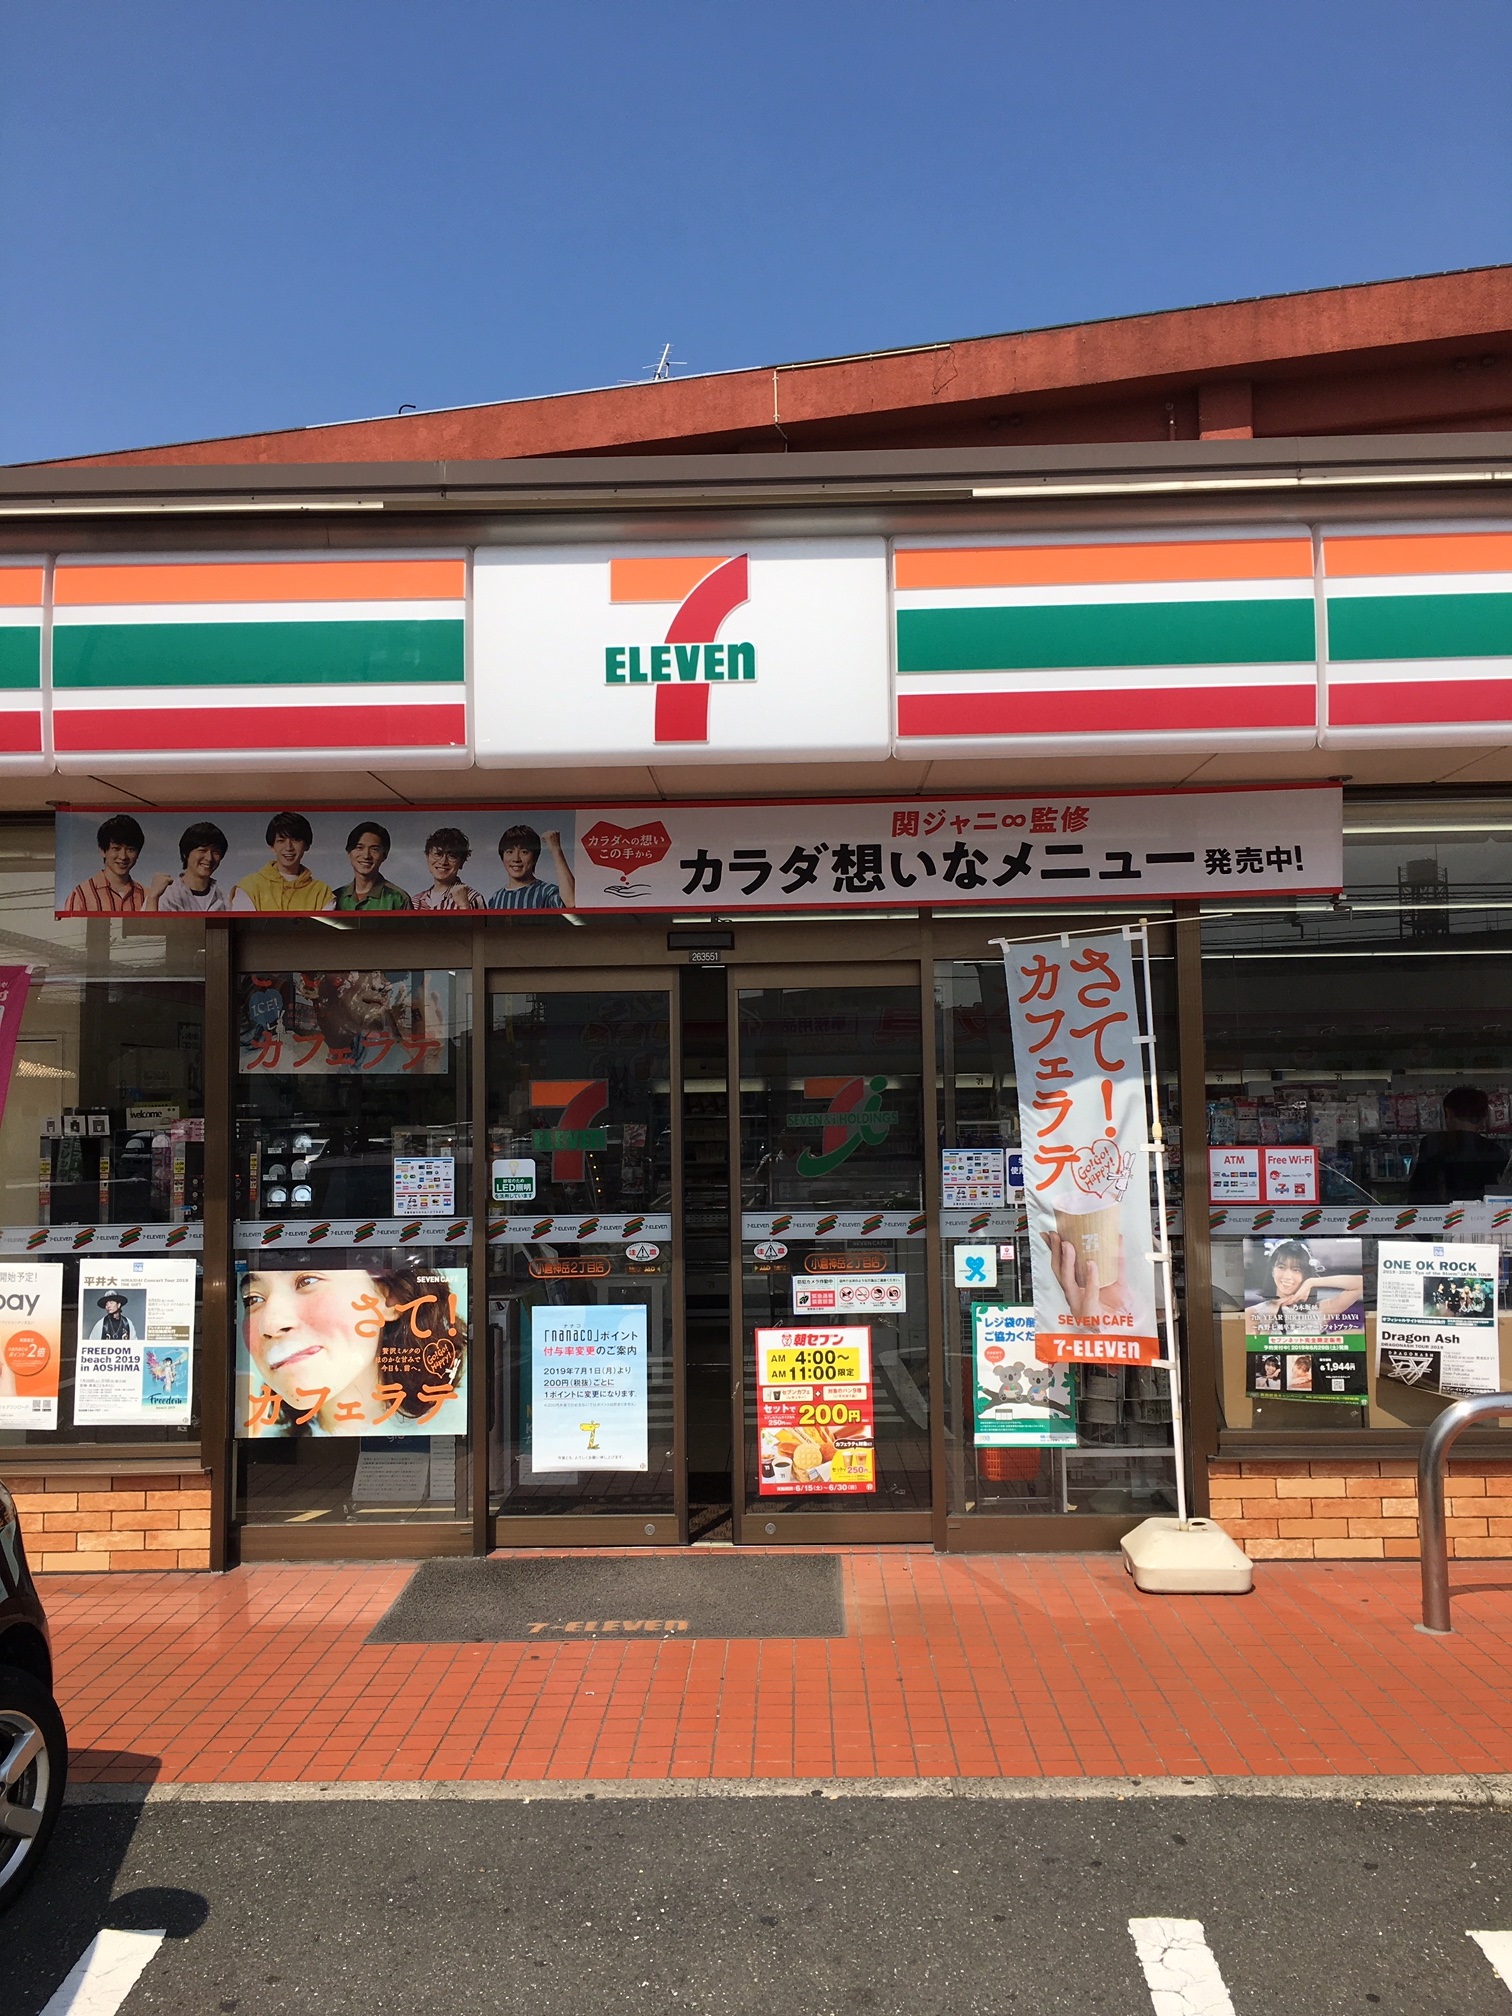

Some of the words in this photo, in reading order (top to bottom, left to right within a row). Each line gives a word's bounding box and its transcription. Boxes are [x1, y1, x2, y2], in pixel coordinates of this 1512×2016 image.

[891, 805, 1090, 838] 関ジャニ∞監修
[588, 833, 665, 847] カラダへの想い
[598, 848, 653, 860] この手から
[680, 842, 1195, 896] カラダ想いなメニュー
[1203, 845, 1304, 875] 発売中!
[691, 951, 719, 962] 263551
[1069, 948, 1128, 1138] さて!
[247, 1031, 441, 1070] カフェラテ
[1018, 954, 1081, 1191] カフェラテ
[1224, 1155, 1245, 1164] ATM
[1268, 1156, 1287, 1164] Free
[1288, 1156, 1312, 1164] Wi-Fi
[496, 1183, 532, 1192] LED照明
[1383, 1260, 1411, 1270] ONE
[1416, 1261, 1435, 1270] OK
[1439, 1261, 1477, 1272] ROCK
[84, 1276, 118, 1286] 平井大
[351, 1293, 458, 1339] さて!
[1058, 1314, 1101, 1326] SEVEN
[1102, 1312, 1134, 1327] CAFÉ
[793, 1334, 844, 1347] 朝セブン
[985, 1331, 1036, 1342] ご協力くだ
[1381, 1331, 1430, 1343] Dragon
[1435, 1333, 1460, 1344] Ash
[81, 1347, 131, 1355] FREEDOM
[543, 1346, 637, 1357] 付与率変更のご案内
[115, 1355, 140, 1363] 2019
[771, 1355, 786, 1363] AM
[92, 1364, 140, 1372] AOSHIMA
[771, 1370, 786, 1378] AM
[149, 1393, 182, 1406] Freedom
[244, 1383, 458, 1428] カフェラテ
[763, 1404, 797, 1414] セットで
[798, 1403, 861, 1425] 200円
